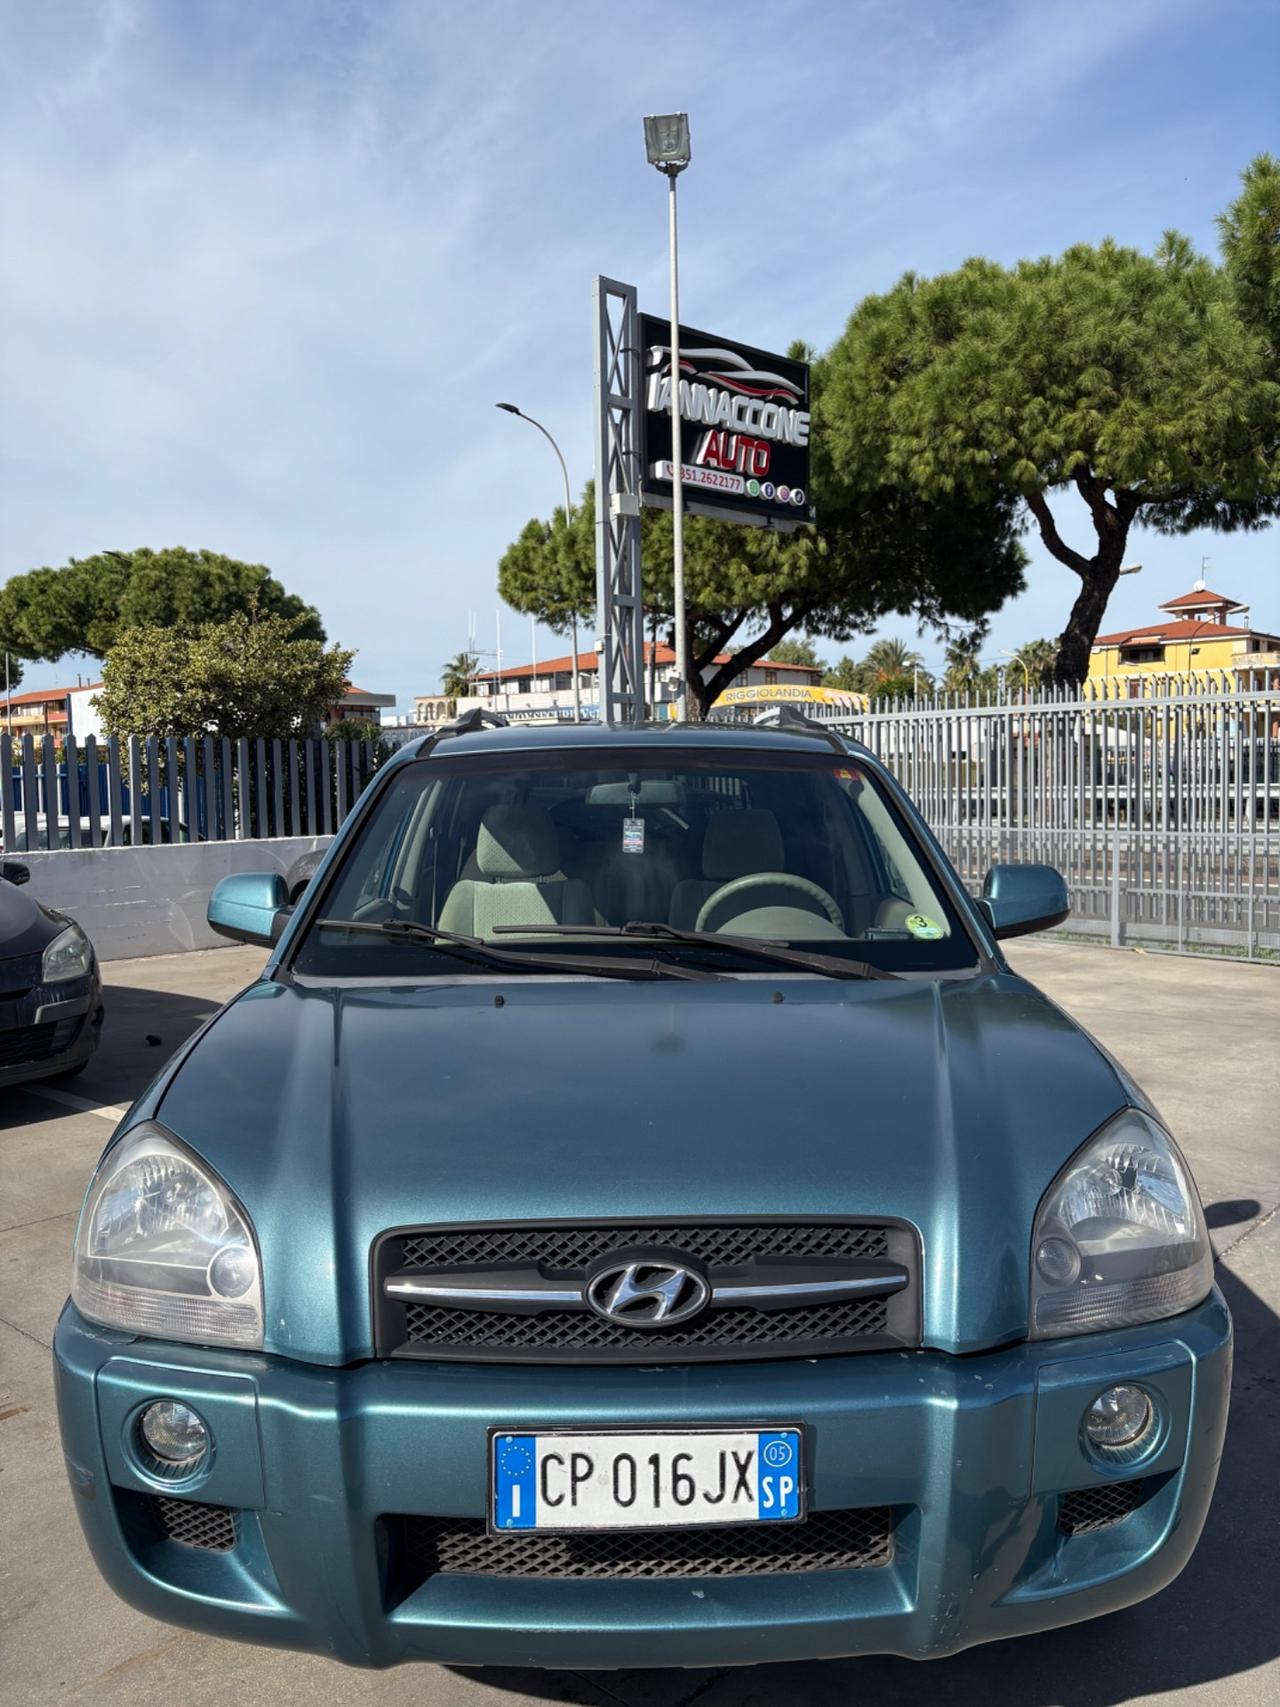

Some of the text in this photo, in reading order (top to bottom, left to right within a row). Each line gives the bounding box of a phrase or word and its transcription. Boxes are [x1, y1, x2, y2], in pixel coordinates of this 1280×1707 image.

[648, 372, 810, 446] IANNACCONE
[697, 429, 771, 477] AUTO
[726, 688, 812, 702] RIGGIOLANDIA
[914, 915, 928, 928] 3
[769, 1445, 786, 1462] 05
[540, 1452, 594, 1507] CP
[762, 1476, 794, 1509] SP
[511, 1484, 521, 1518] I
